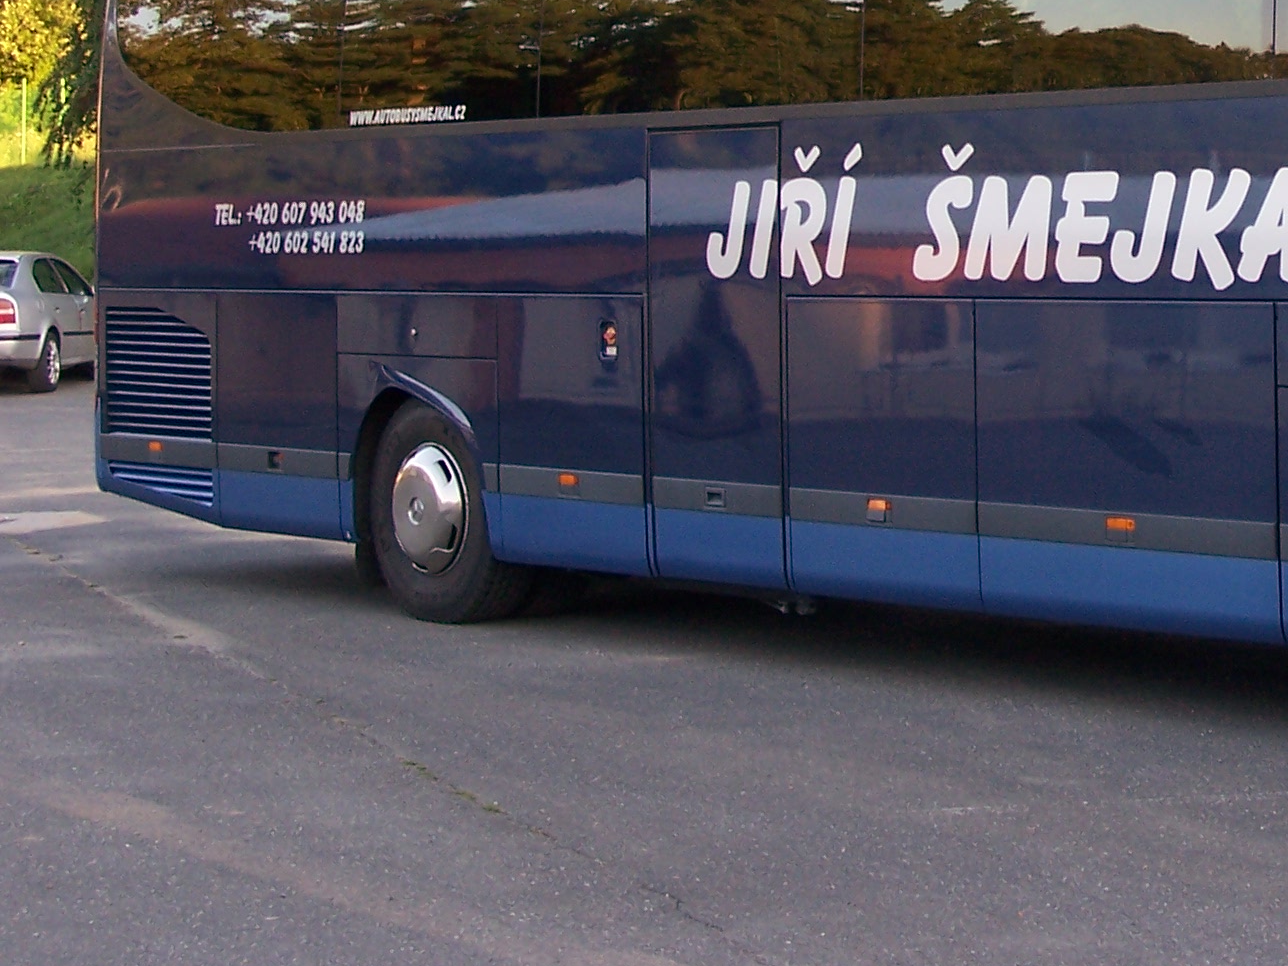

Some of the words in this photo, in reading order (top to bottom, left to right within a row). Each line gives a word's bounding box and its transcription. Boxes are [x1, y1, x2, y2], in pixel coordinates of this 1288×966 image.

[246, 202, 278, 225] +420
[282, 201, 306, 224] 607
[310, 201, 334, 223] 943
[339, 200, 366, 223] 048
[706, 142, 863, 287] JIŘÍ
[249, 232, 281, 254] +420
[284, 232, 308, 254] 602
[312, 231, 335, 254] 541
[339, 231, 365, 253] 823
